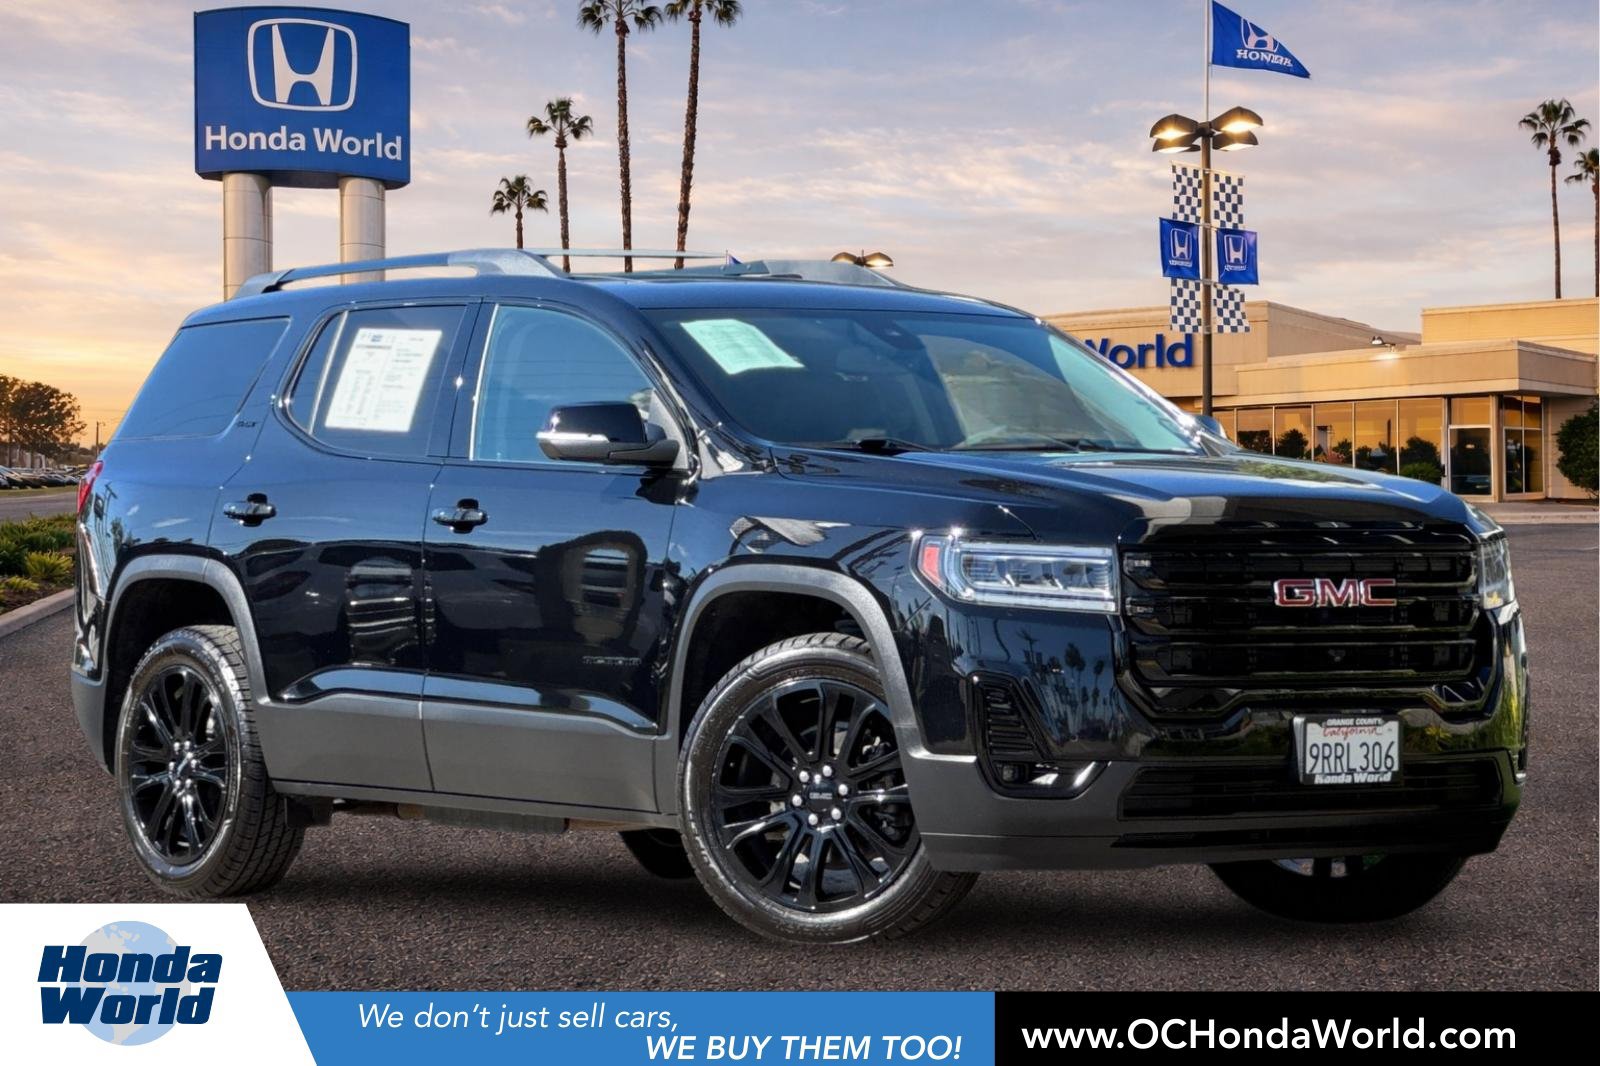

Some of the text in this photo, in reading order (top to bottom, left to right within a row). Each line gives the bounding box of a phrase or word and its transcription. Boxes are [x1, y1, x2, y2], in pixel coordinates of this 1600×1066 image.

[205, 125, 402, 161] Honda World
[1273, 577, 1397, 608] GMC
[1309, 741, 1395, 773] 9RRL306
[1314, 771, 1392, 785] Honda World
